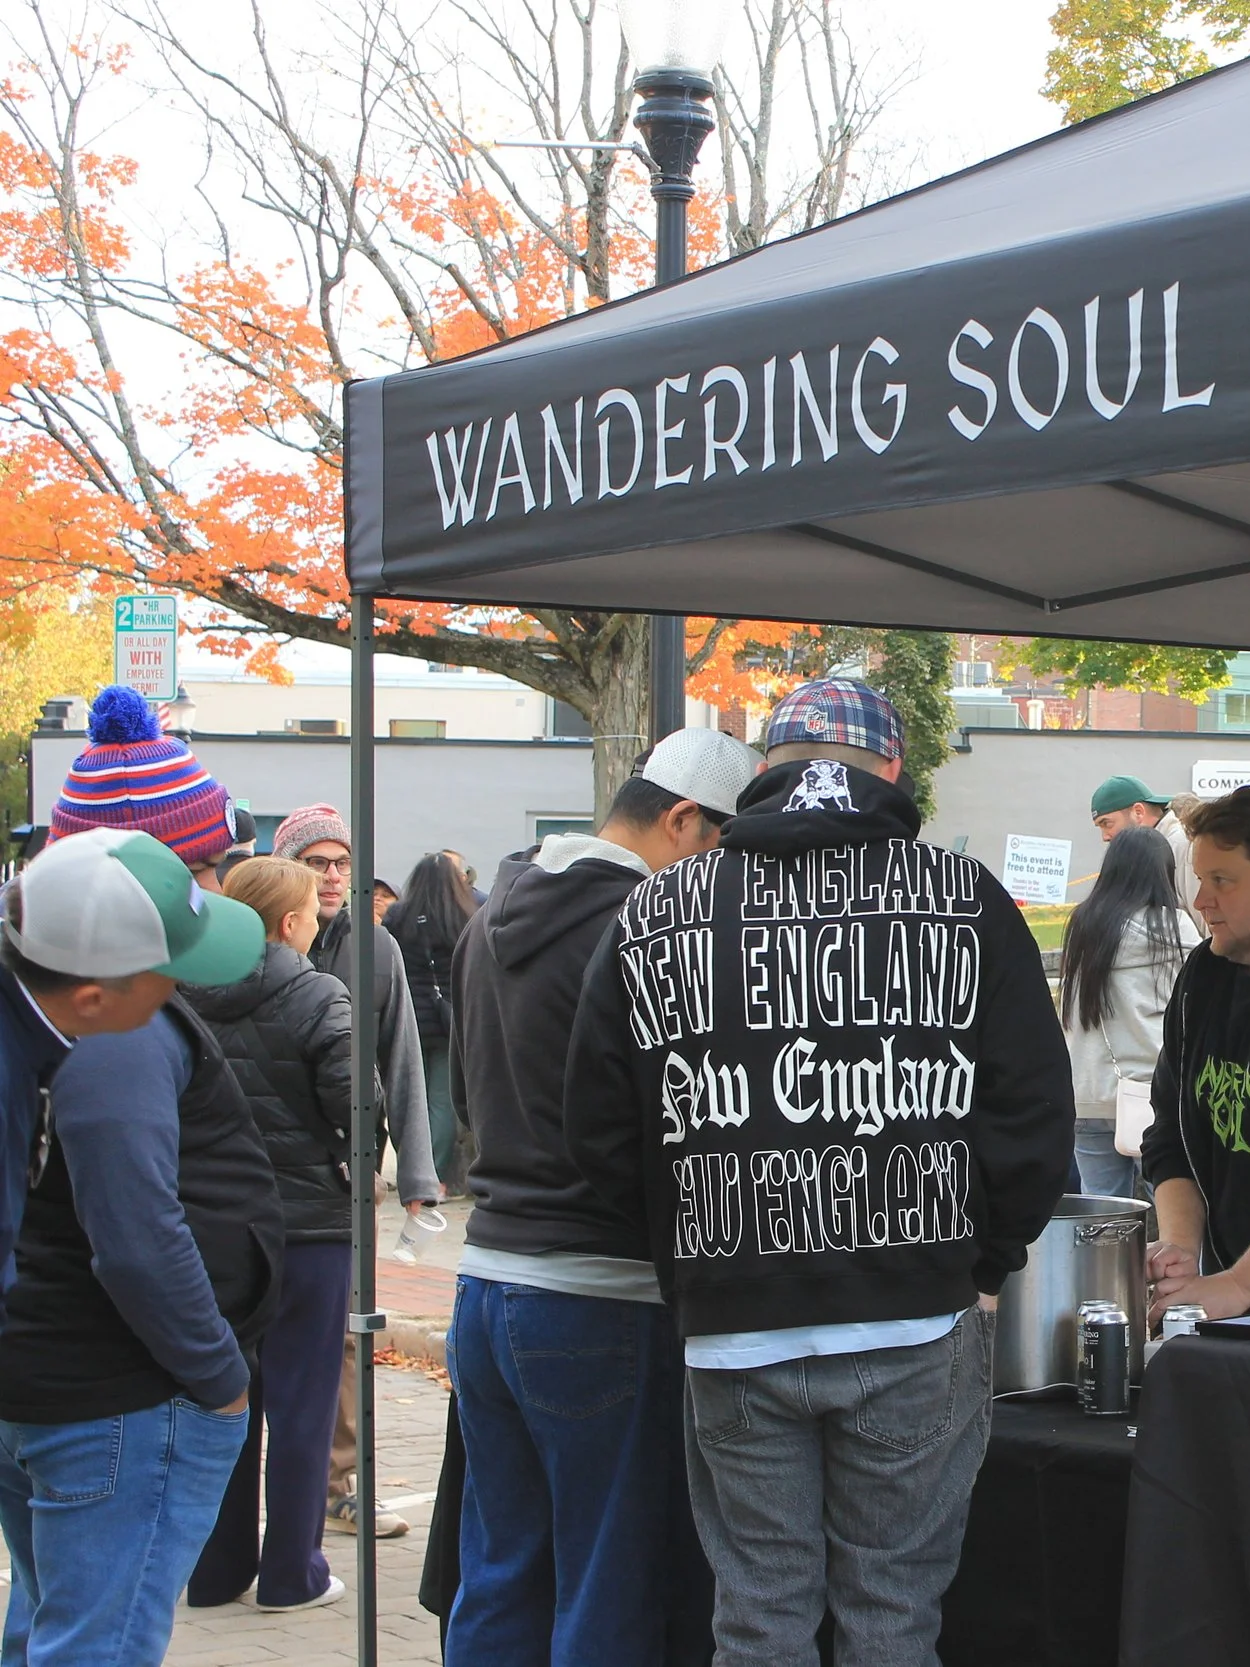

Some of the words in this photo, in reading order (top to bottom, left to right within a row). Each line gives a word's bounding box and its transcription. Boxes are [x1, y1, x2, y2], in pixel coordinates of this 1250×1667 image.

[425, 336, 906, 531] WANDERING
[948, 281, 1215, 441] SOUL
[148, 600, 159, 612] HR
[117, 601, 131, 626] 2
[134, 613, 173, 625] PARKING
[124, 637, 134, 647] OR
[137, 637, 150, 647] ALL
[153, 637, 167, 647] DAY
[130, 651, 162, 665] WITH
[126, 669, 164, 680] EMPLOYEE
[808, 719, 825, 731] NFL
[1011, 853, 1027, 863] This
[1030, 856, 1053, 866] event
[1055, 857, 1063, 867] is
[1007, 862, 1025, 872] free
[1026, 864, 1035, 873] to
[1037, 866, 1064, 877] attend
[618, 848, 724, 947] NEW
[741, 839, 982, 921] ENGLAND
[620, 928, 715, 1050] NEW
[741, 921, 980, 1030] ENGLAND
[772, 1034, 976, 1137] England
